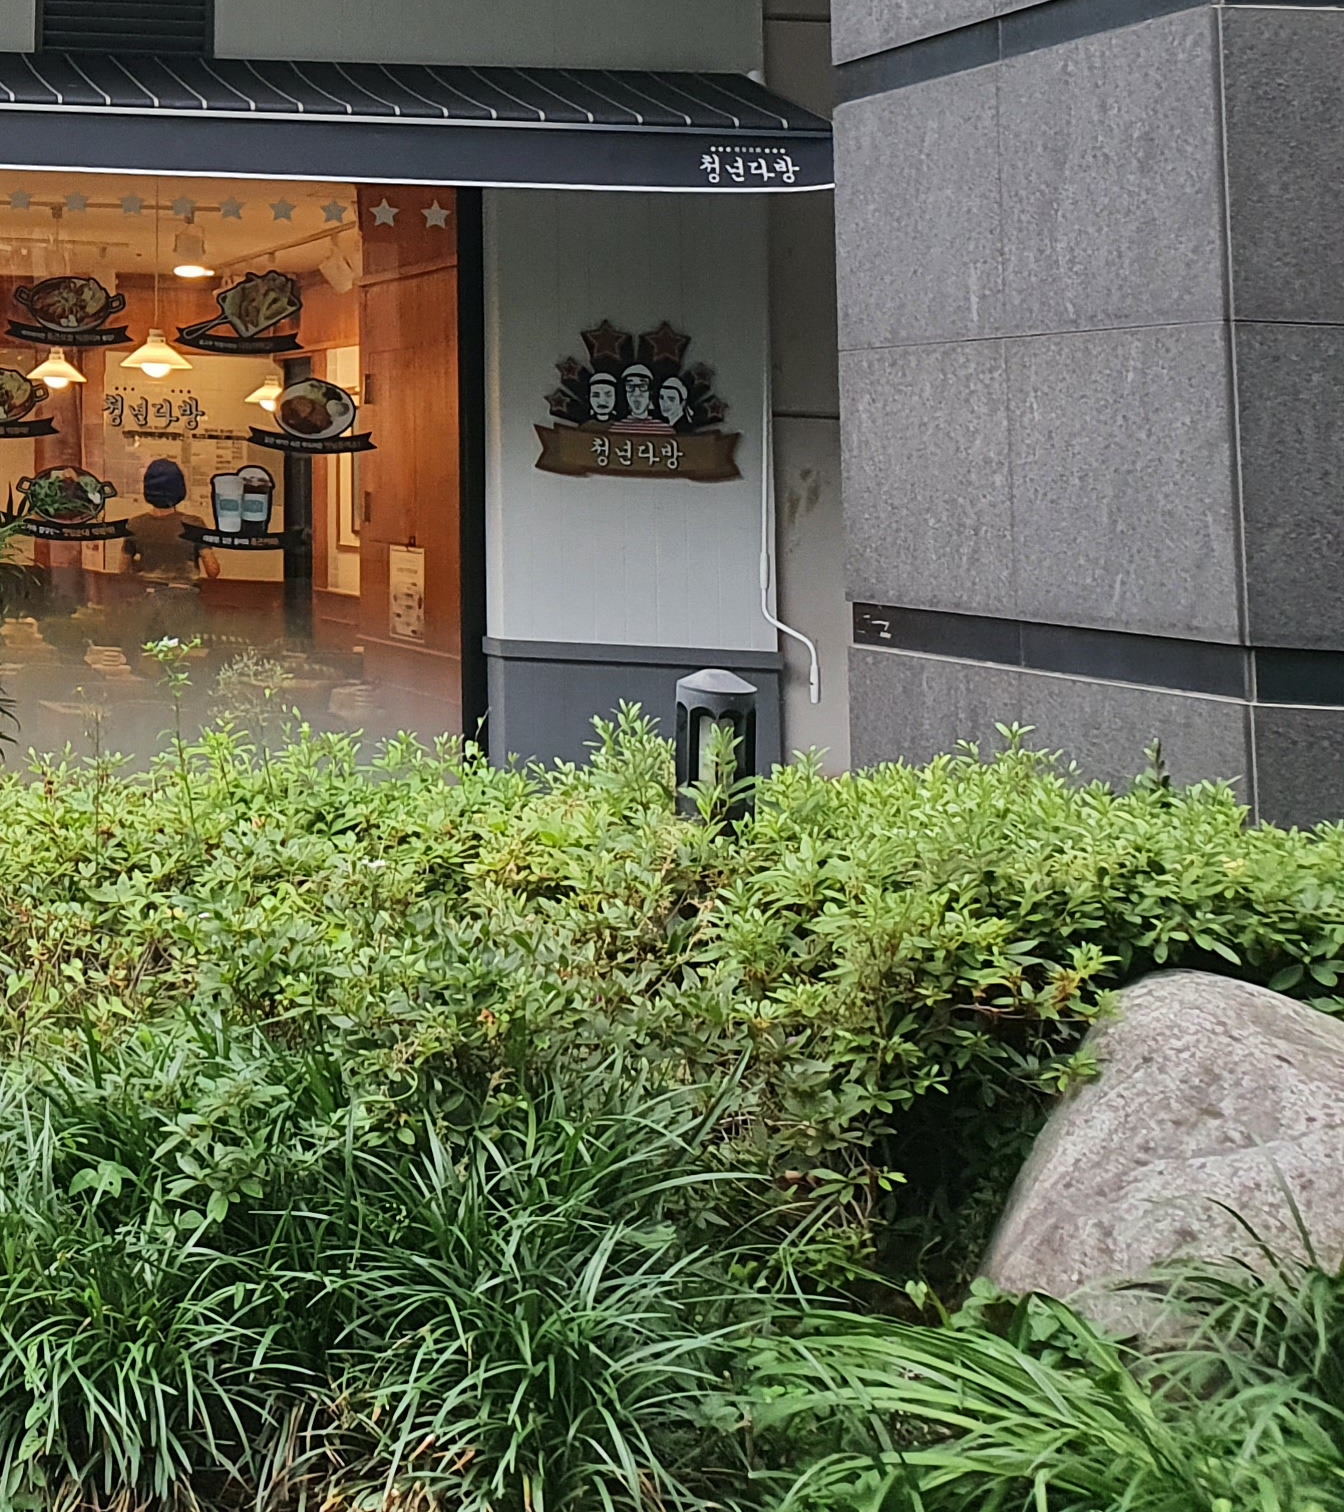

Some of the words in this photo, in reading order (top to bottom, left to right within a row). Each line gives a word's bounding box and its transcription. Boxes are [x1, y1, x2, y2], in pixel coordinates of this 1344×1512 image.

[699, 153, 800, 184] 청년다방
[102, 393, 206, 431] 청년다방
[589, 436, 684, 470] 청년다방
